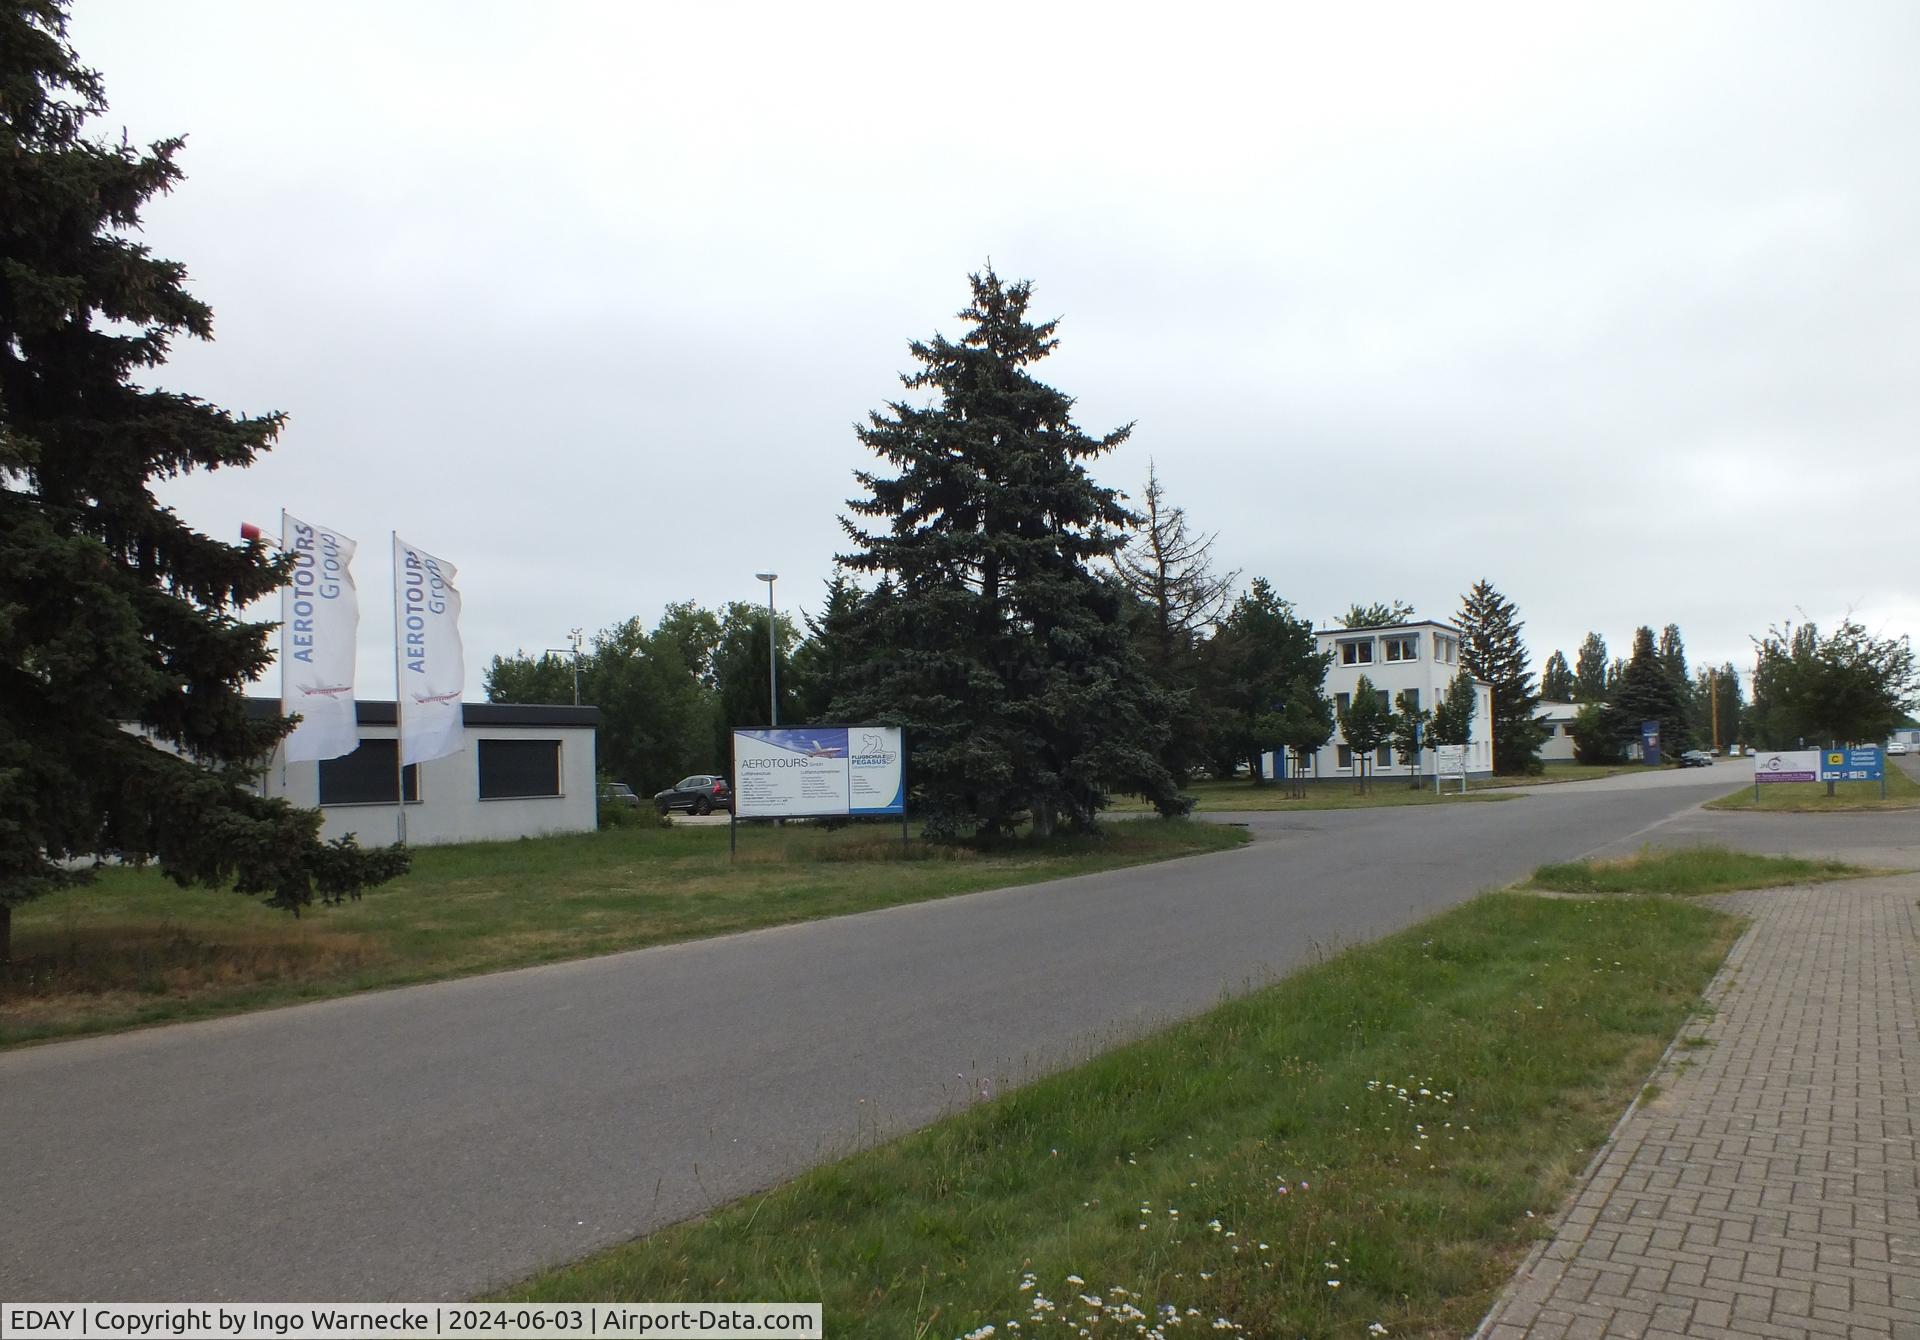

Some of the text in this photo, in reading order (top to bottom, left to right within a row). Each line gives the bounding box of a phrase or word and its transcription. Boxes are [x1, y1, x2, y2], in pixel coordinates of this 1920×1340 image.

[294, 524, 316, 664] AEROTOURS
[319, 533, 341, 600] Group
[405, 550, 425, 674] AEROTOURS
[741, 758, 809, 769] AEROTOURS
